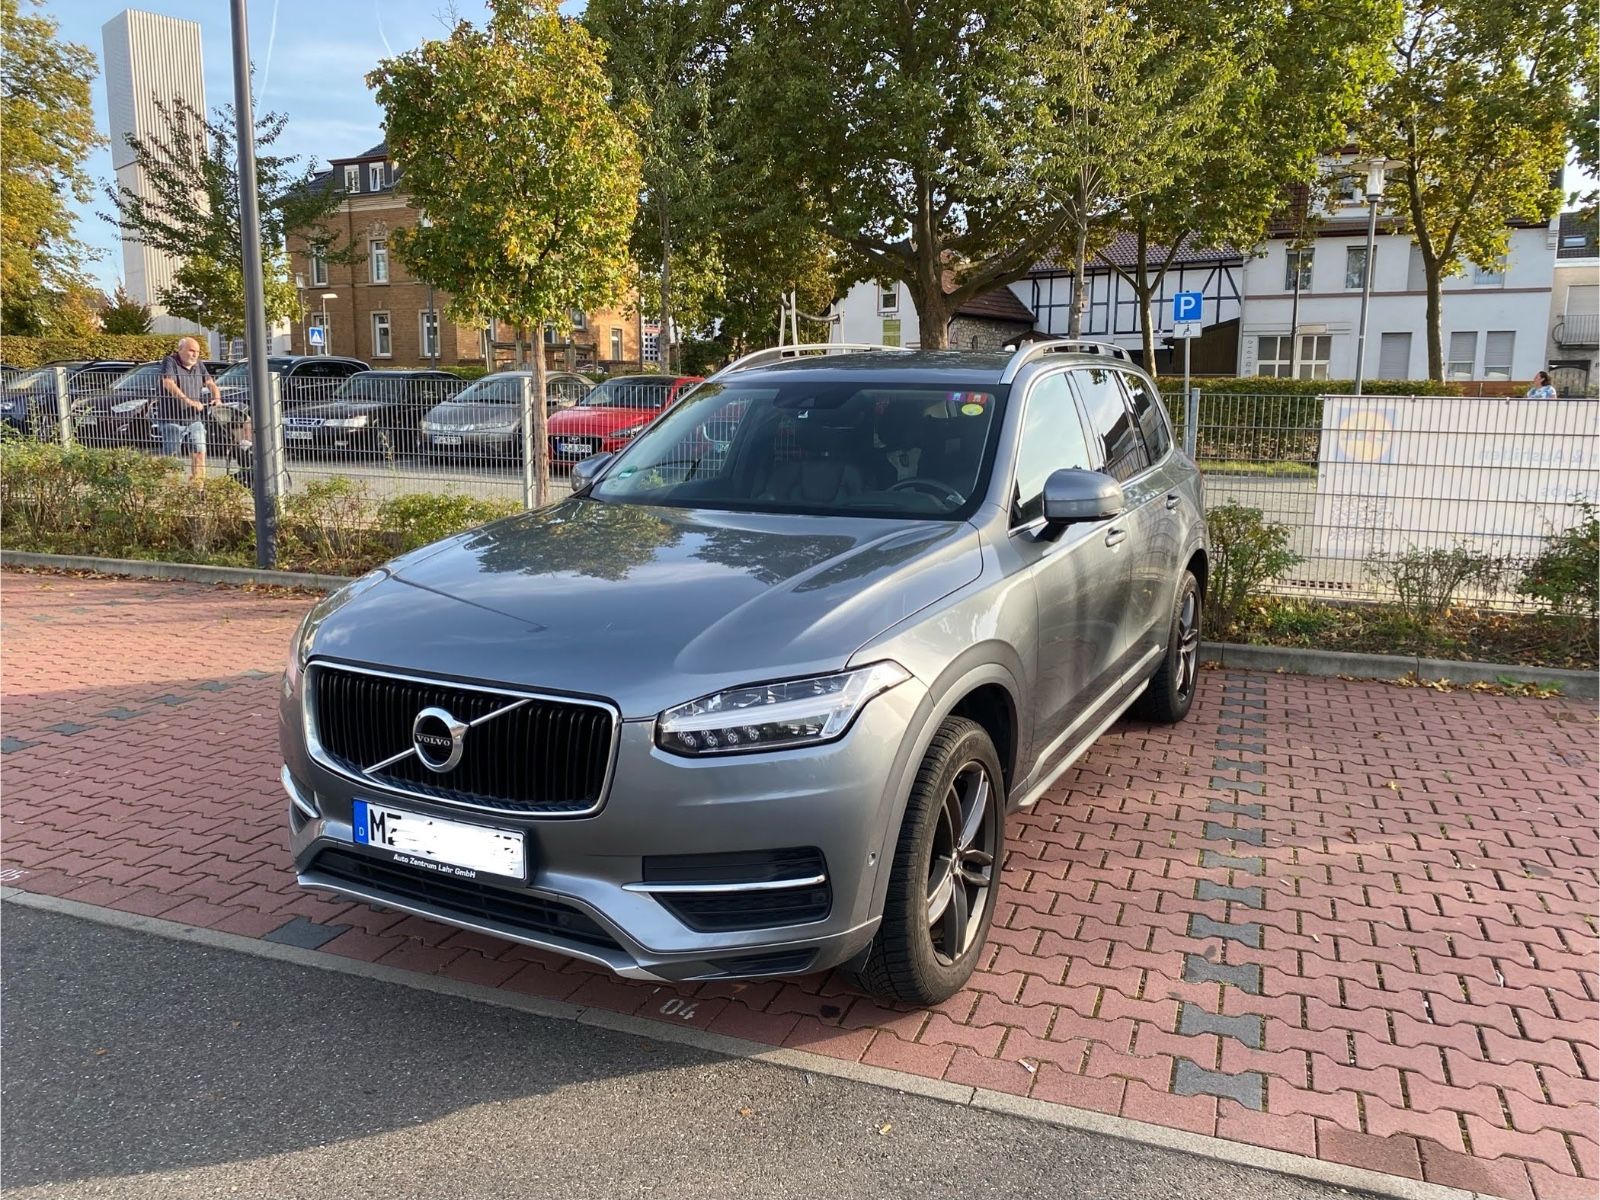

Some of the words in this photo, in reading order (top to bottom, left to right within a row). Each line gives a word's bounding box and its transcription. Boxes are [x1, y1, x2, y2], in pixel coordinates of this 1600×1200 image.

[1180, 296, 1196, 318] P
[416, 735, 451, 747] VOLVO
[358, 826, 365, 837] D
[393, 853, 409, 863] Auto
[409, 857, 437, 870] Zentrum
[438, 863, 454, 874] Lahr
[454, 867, 476, 879] GmbH
[659, 998, 699, 1020] 04
